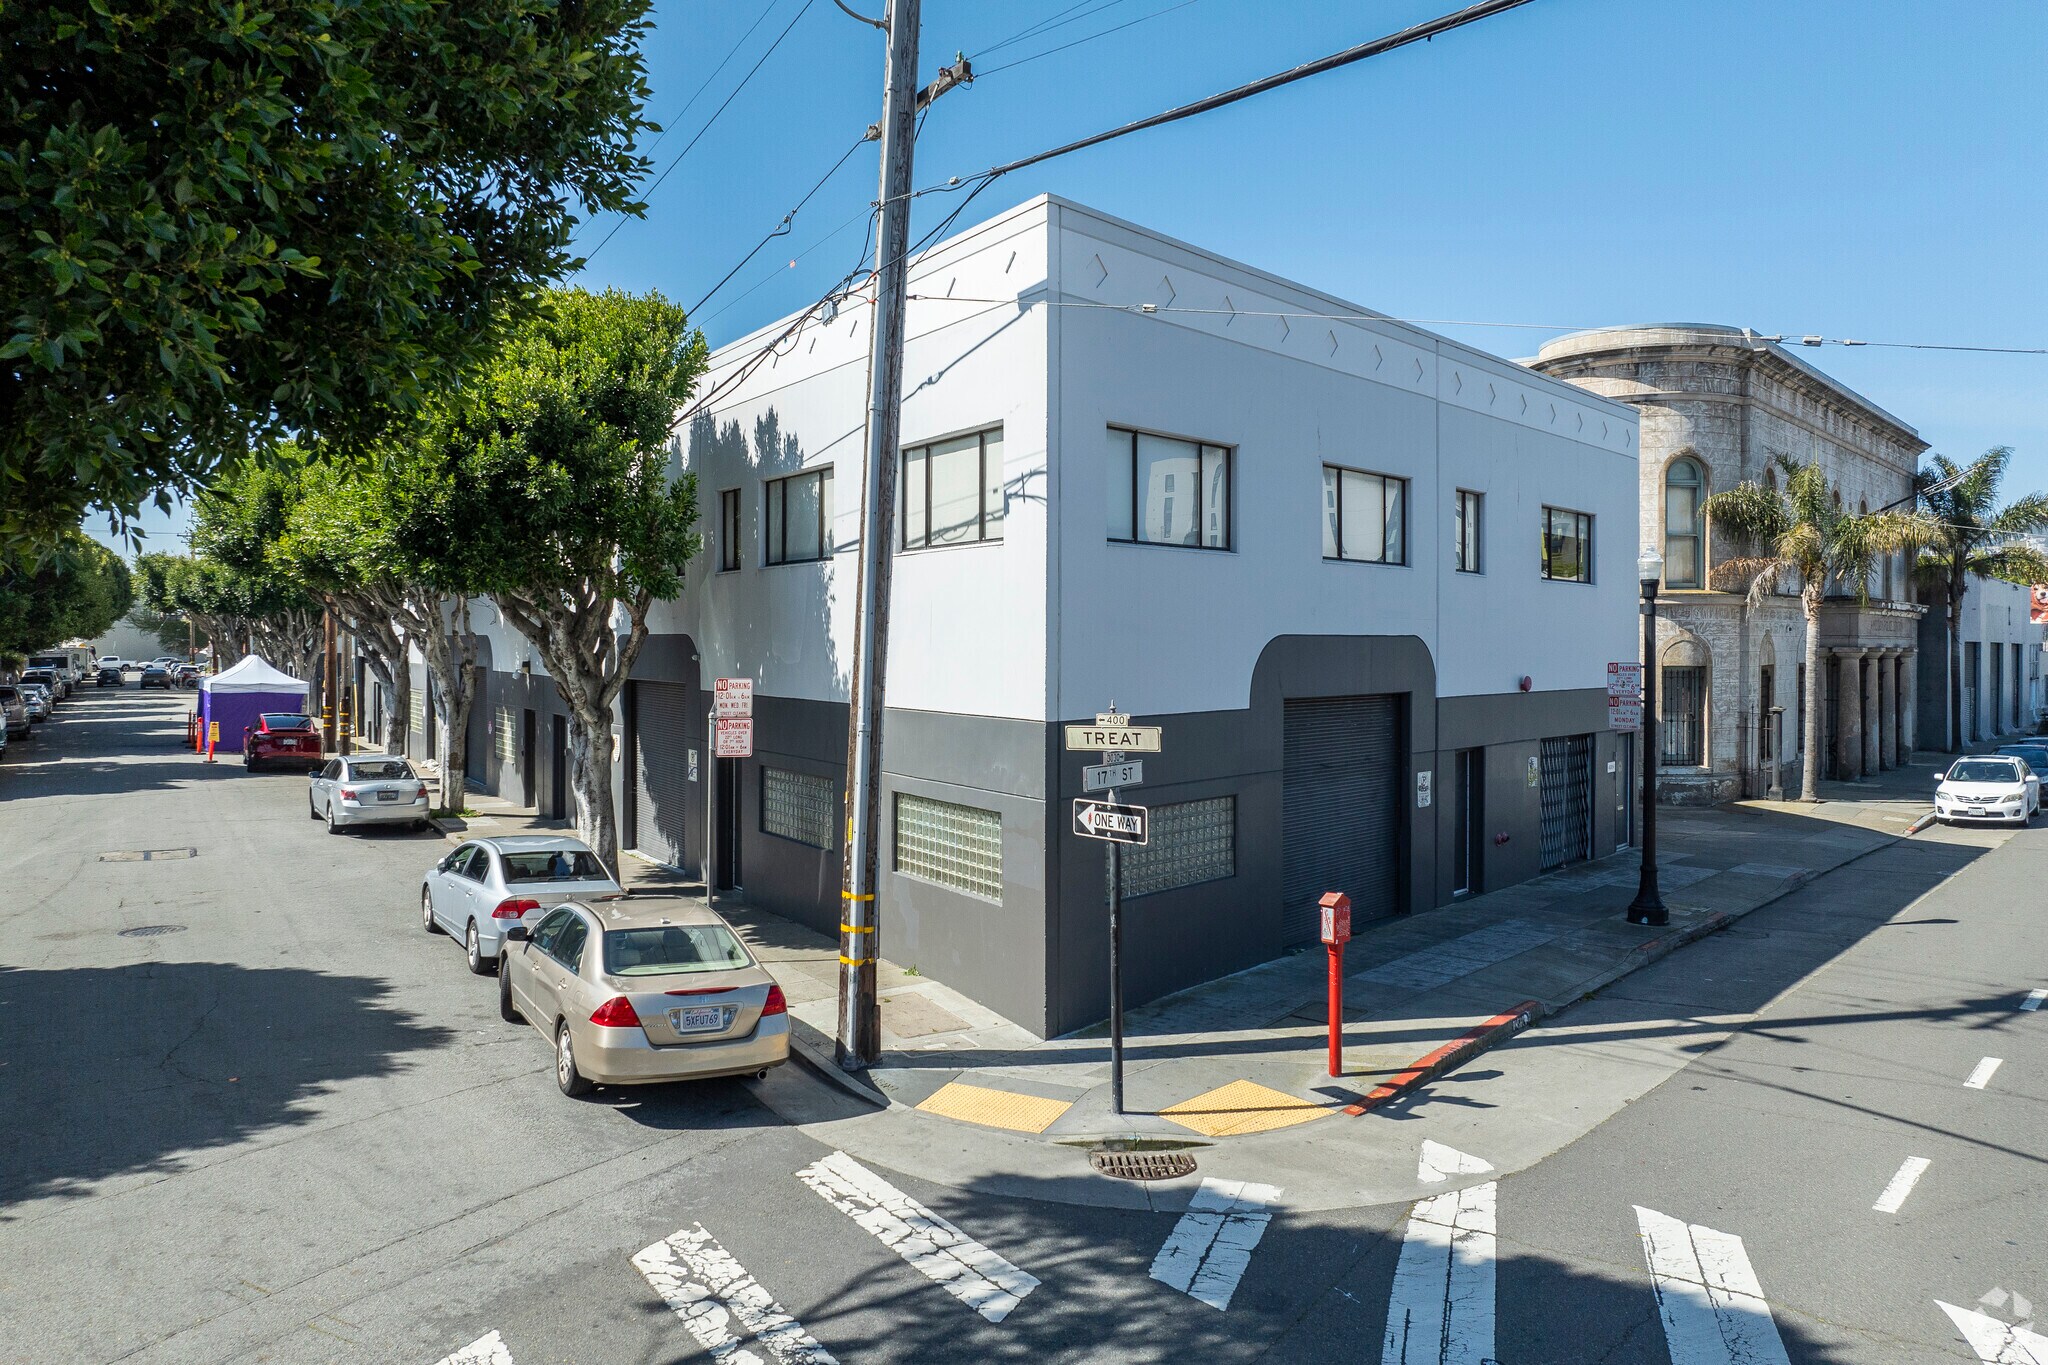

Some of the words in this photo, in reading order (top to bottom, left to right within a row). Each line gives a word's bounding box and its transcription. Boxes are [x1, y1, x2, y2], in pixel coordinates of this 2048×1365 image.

[1608, 663, 1618, 673] NO
[717, 679, 728, 690] NO
[729, 682, 750, 690] PARKING
[1609, 697, 1619, 707] NO
[1620, 699, 1640, 707] PARKING
[717, 719, 728, 730] NO
[729, 722, 751, 730] PARKING
[1107, 716, 1125, 725] 400
[1083, 732, 1142, 746] TREAT
[1122, 767, 1133, 781] ST
[1094, 813, 1113, 828] ONE
[1117, 815, 1138, 831] WAY
[686, 1014, 718, 1026] 5XFU769
